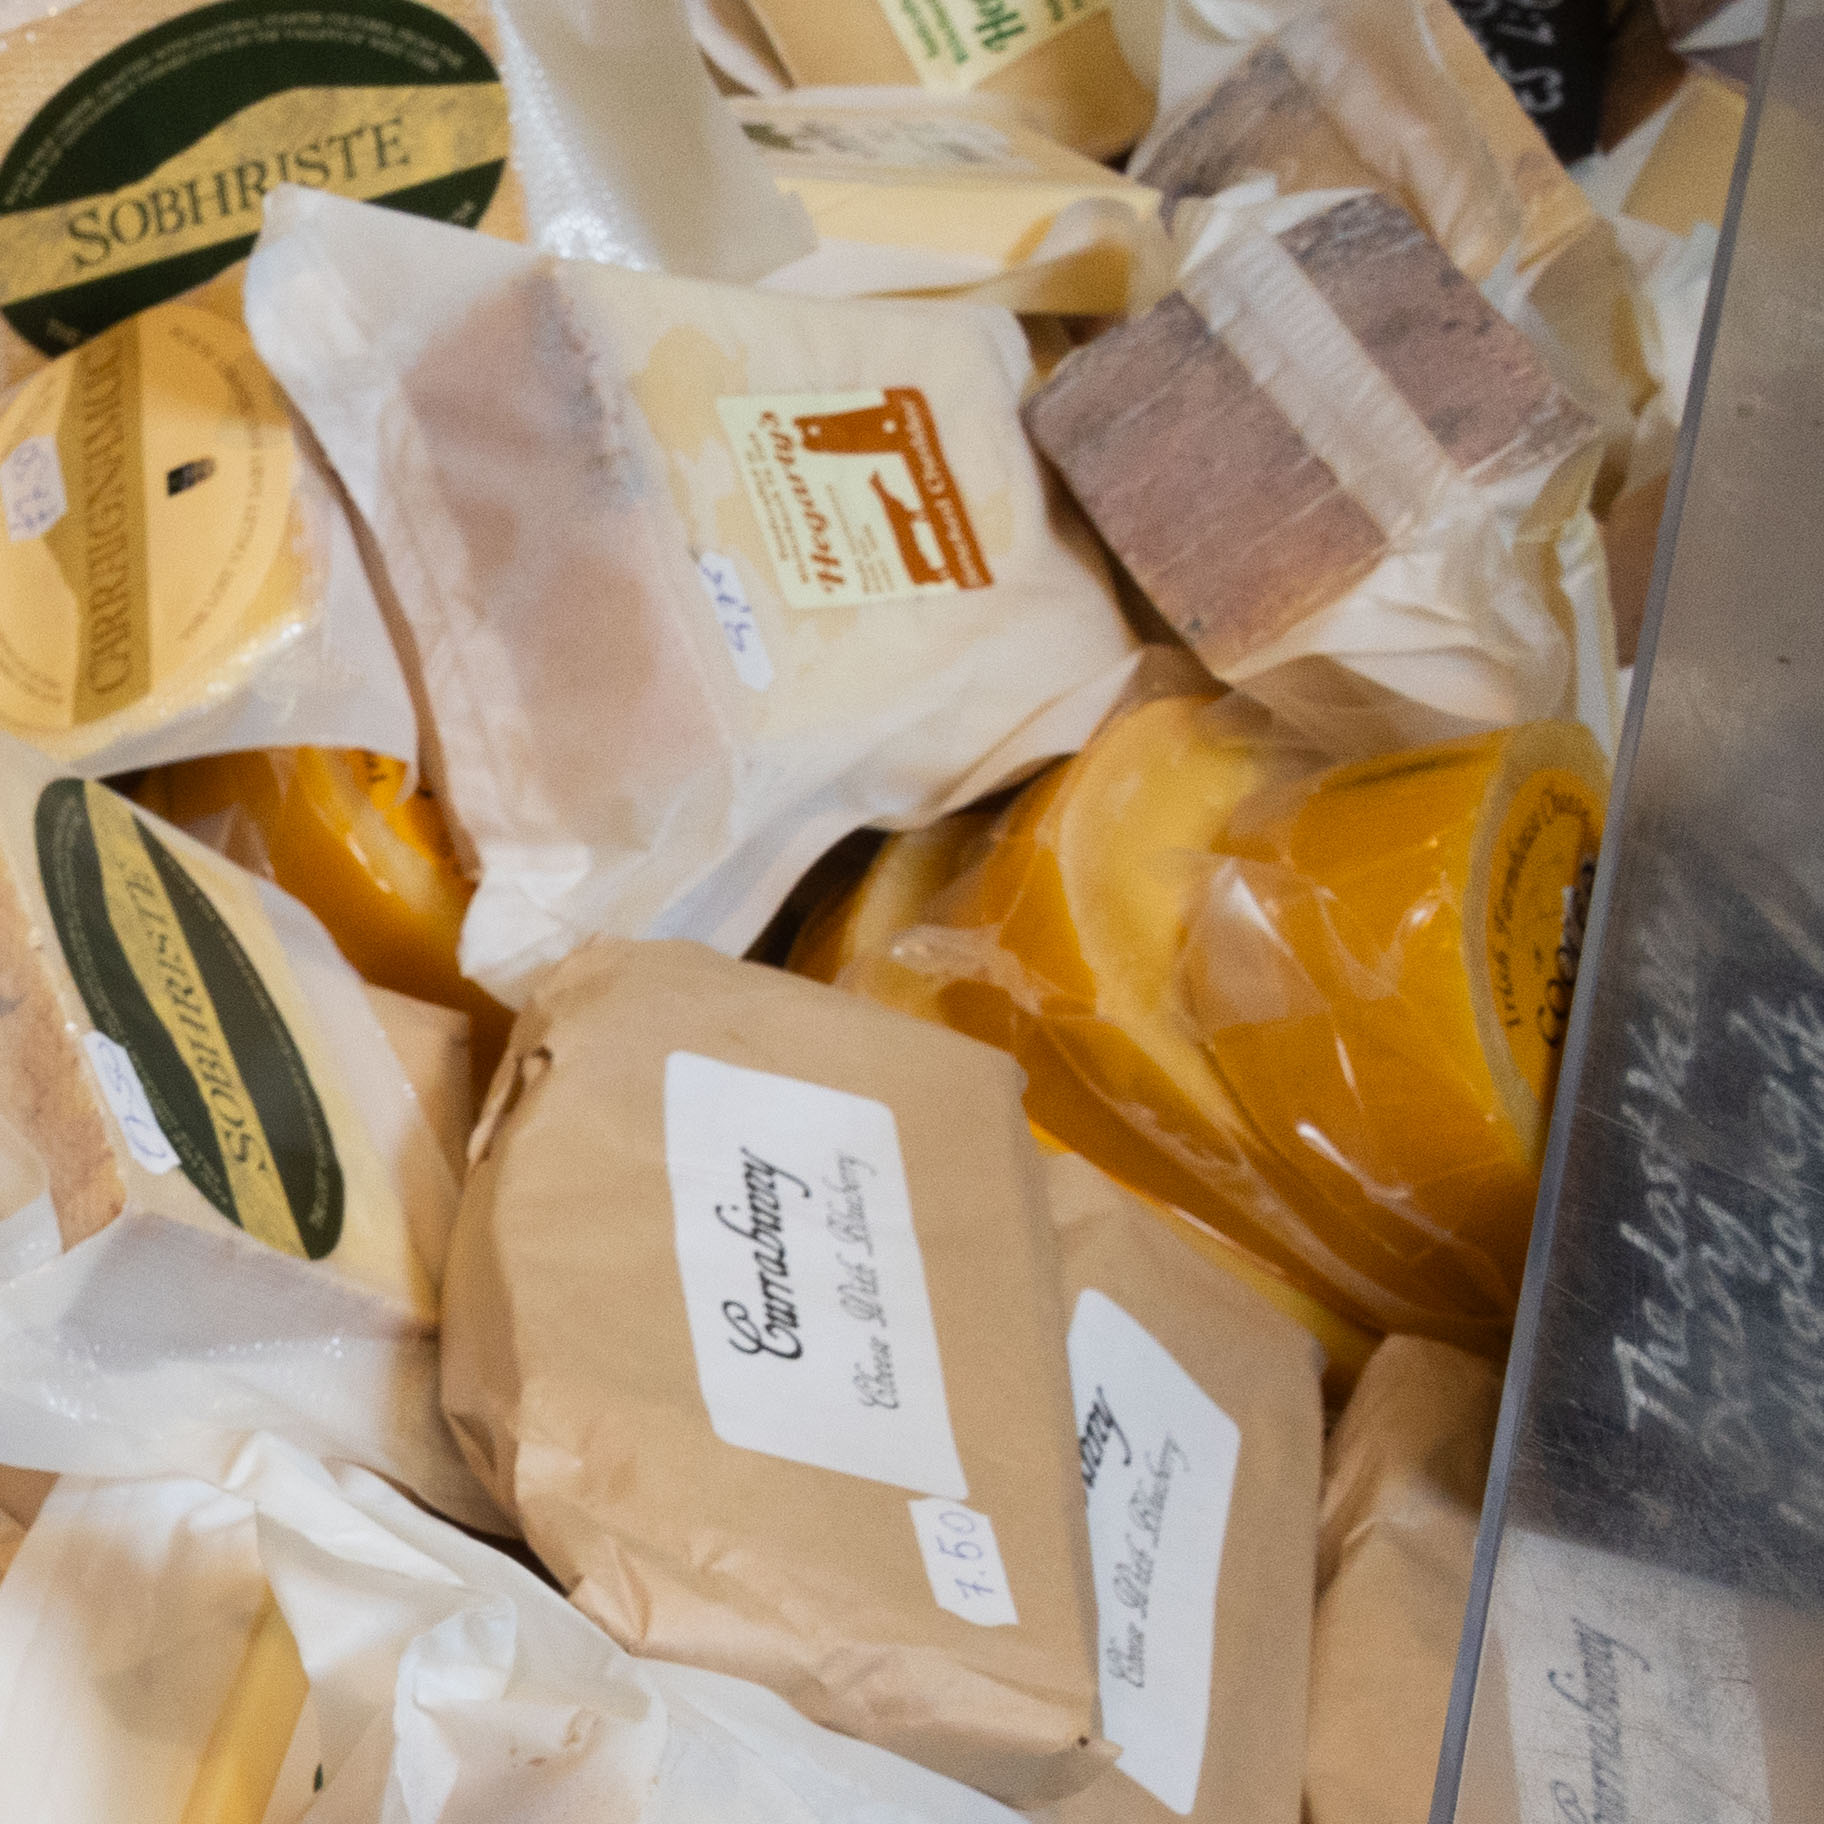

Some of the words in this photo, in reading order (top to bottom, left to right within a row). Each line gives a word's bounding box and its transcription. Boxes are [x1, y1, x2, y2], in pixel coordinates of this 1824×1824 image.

[68, 114, 413, 272] SOBHRISTE
[759, 410, 846, 596] Hegarty's
[120, 859, 257, 1166] SOBHRISTE
[715, 1145, 814, 1363] Currabinny
